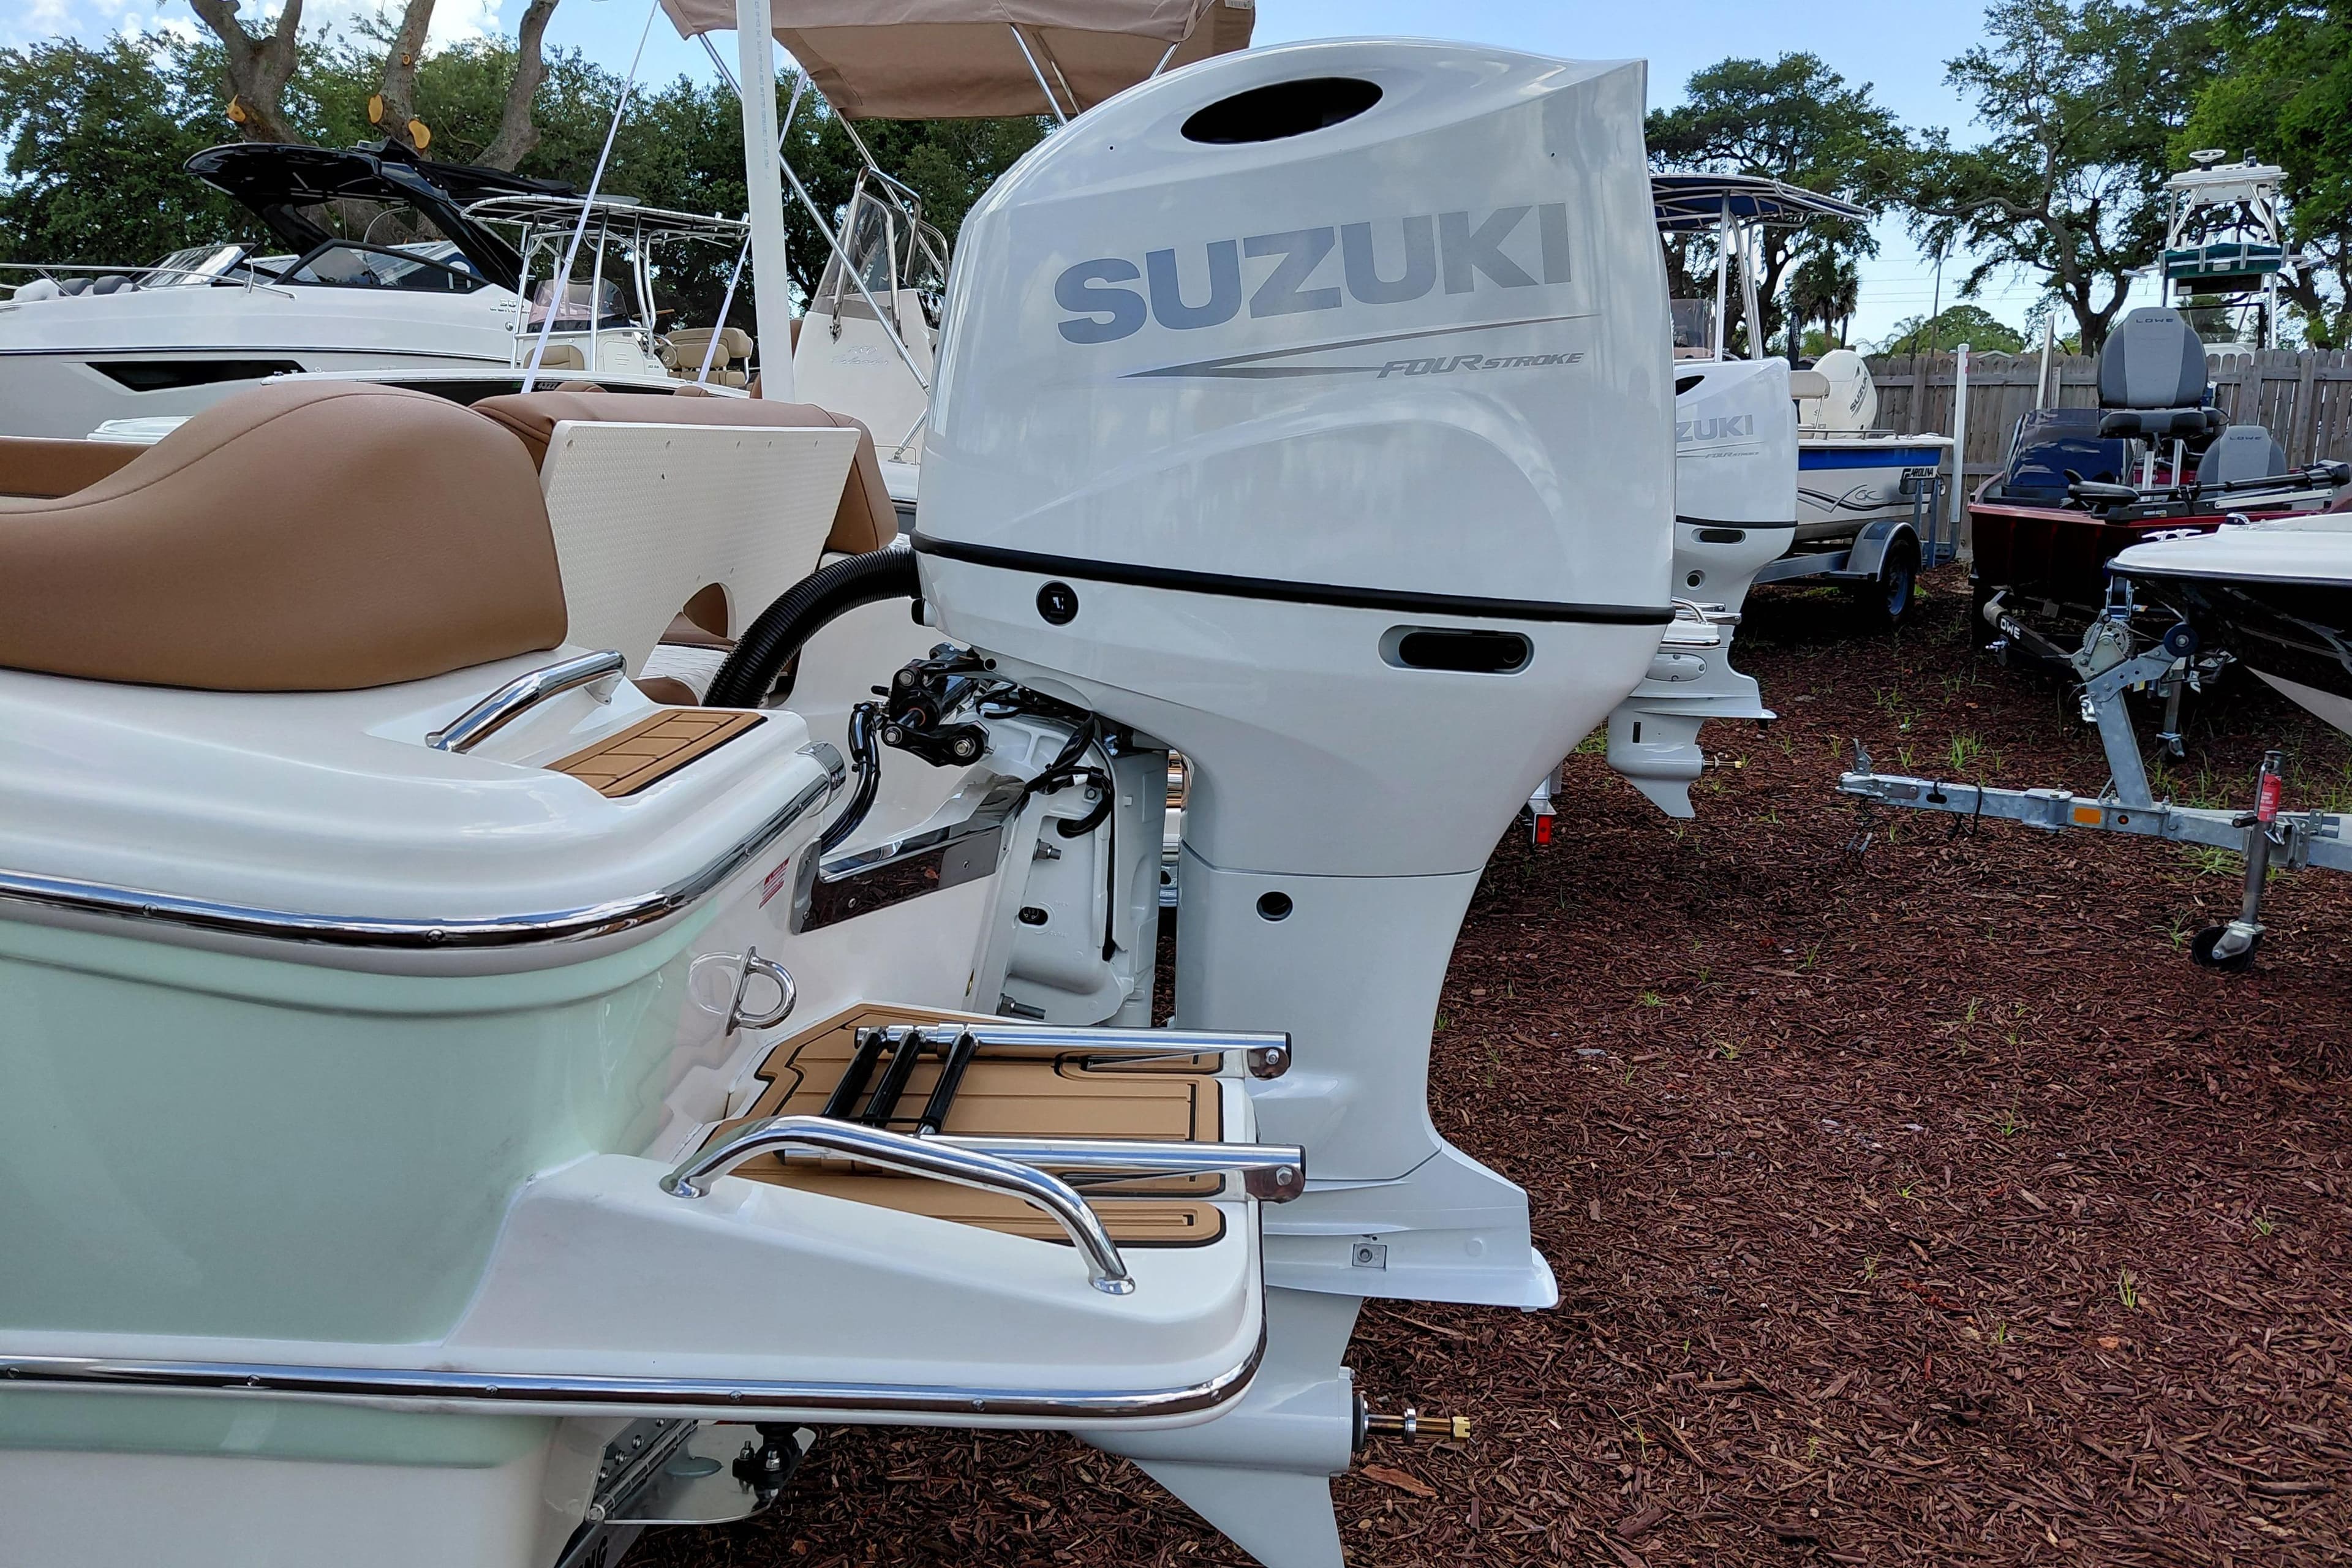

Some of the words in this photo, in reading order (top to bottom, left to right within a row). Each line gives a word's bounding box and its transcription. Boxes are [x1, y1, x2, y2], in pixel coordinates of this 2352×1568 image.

[1054, 202, 1571, 345] SUZUKI
[1376, 354, 1484, 379] FOUR
[1481, 352, 1585, 369] STROKE
